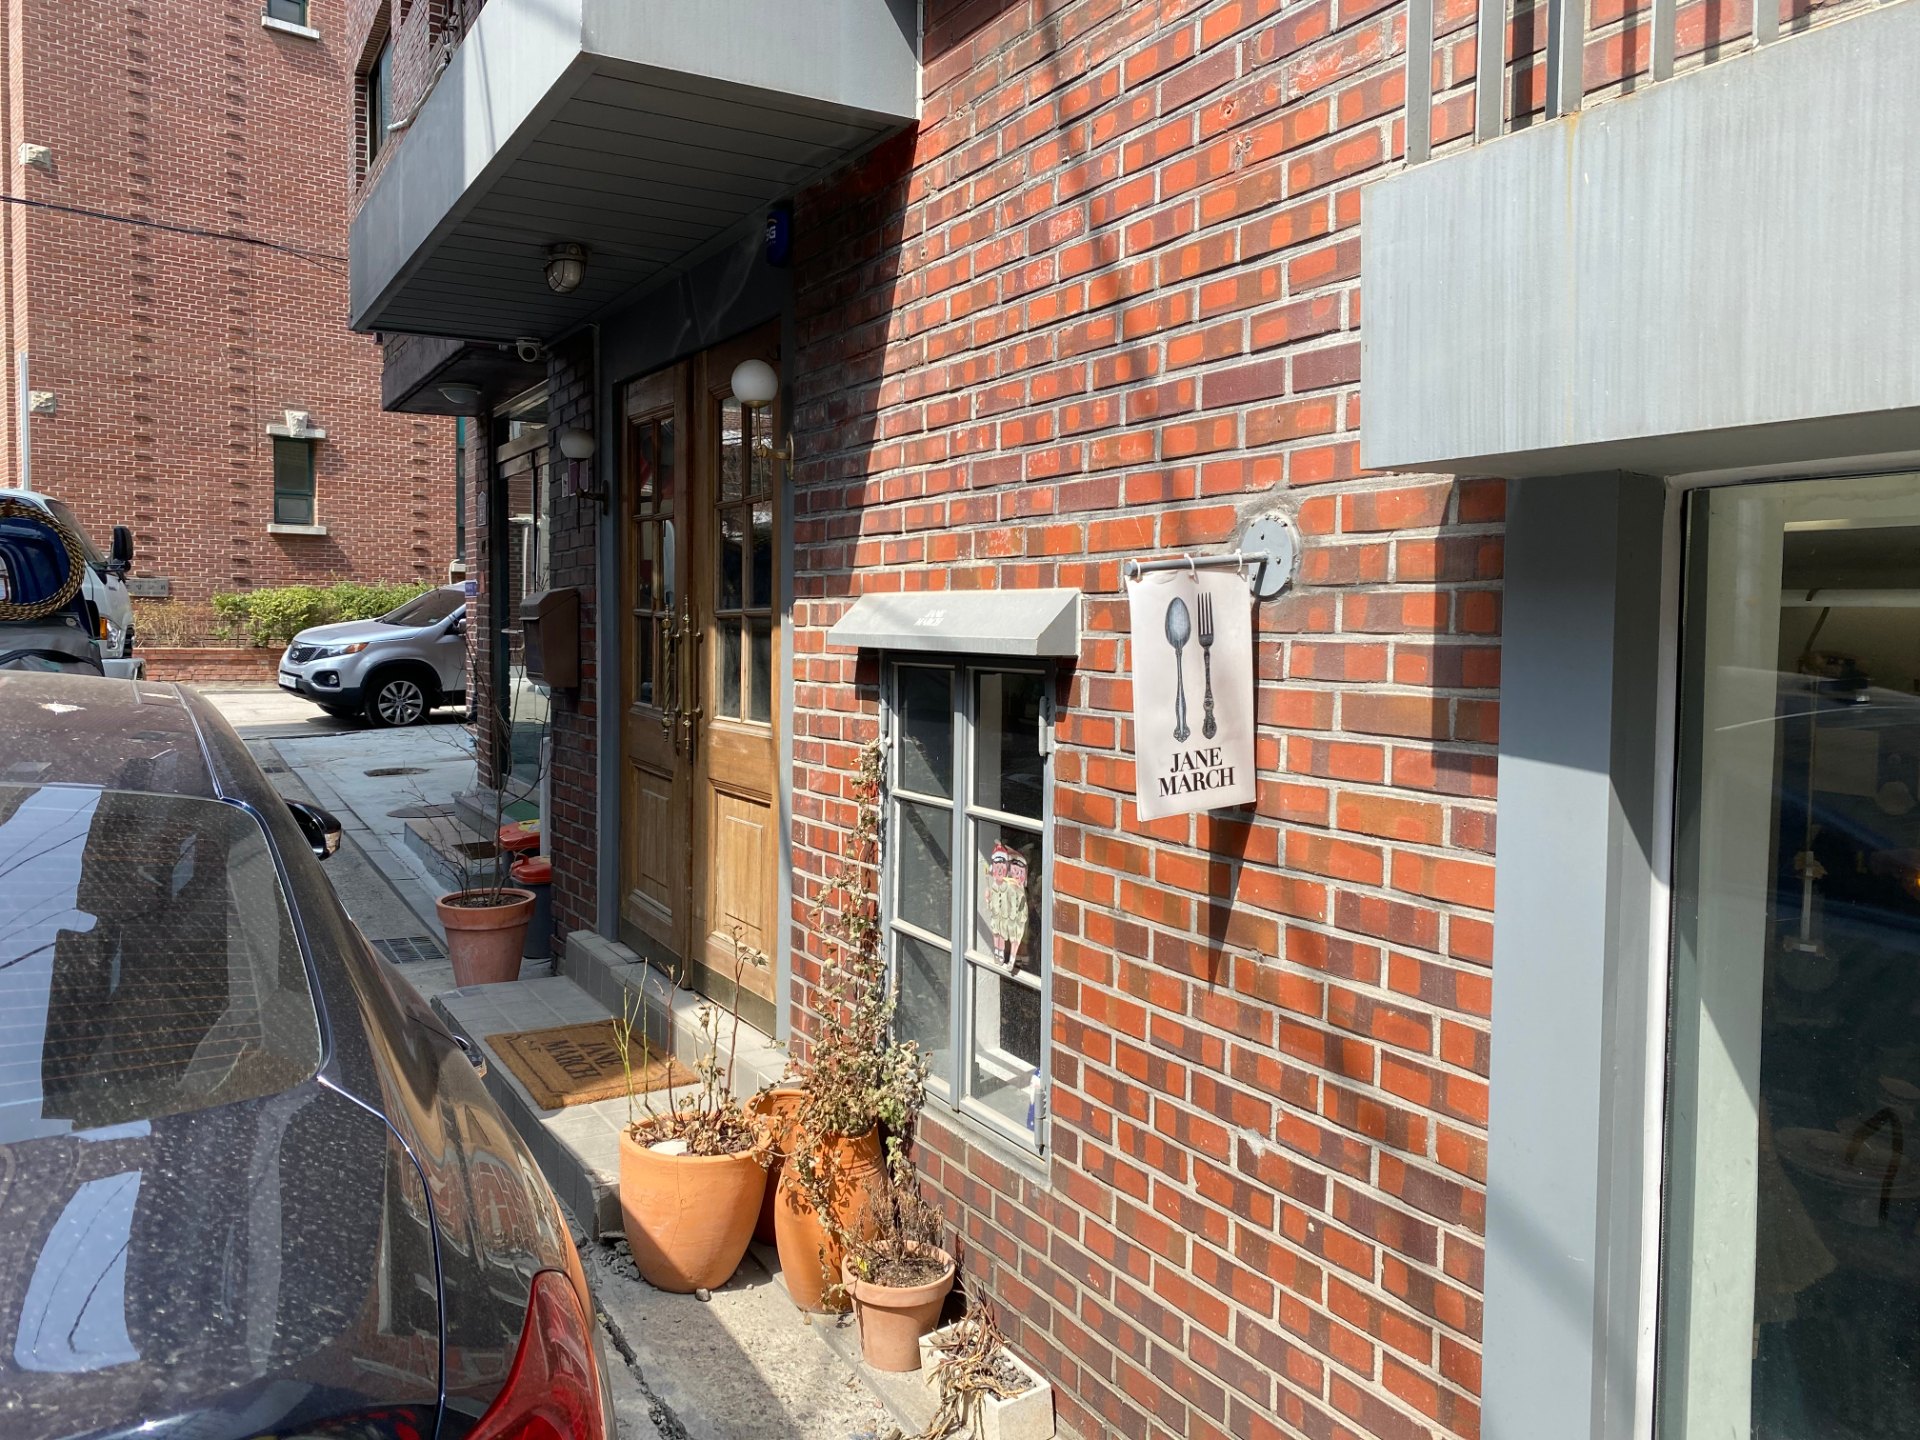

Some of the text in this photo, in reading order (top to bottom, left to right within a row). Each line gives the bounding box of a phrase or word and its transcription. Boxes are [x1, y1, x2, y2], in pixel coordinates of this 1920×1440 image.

[1170, 748, 1223, 773] JANE
[1158, 767, 1234, 797] MARCH
[542, 1039, 602, 1079] MARCH
